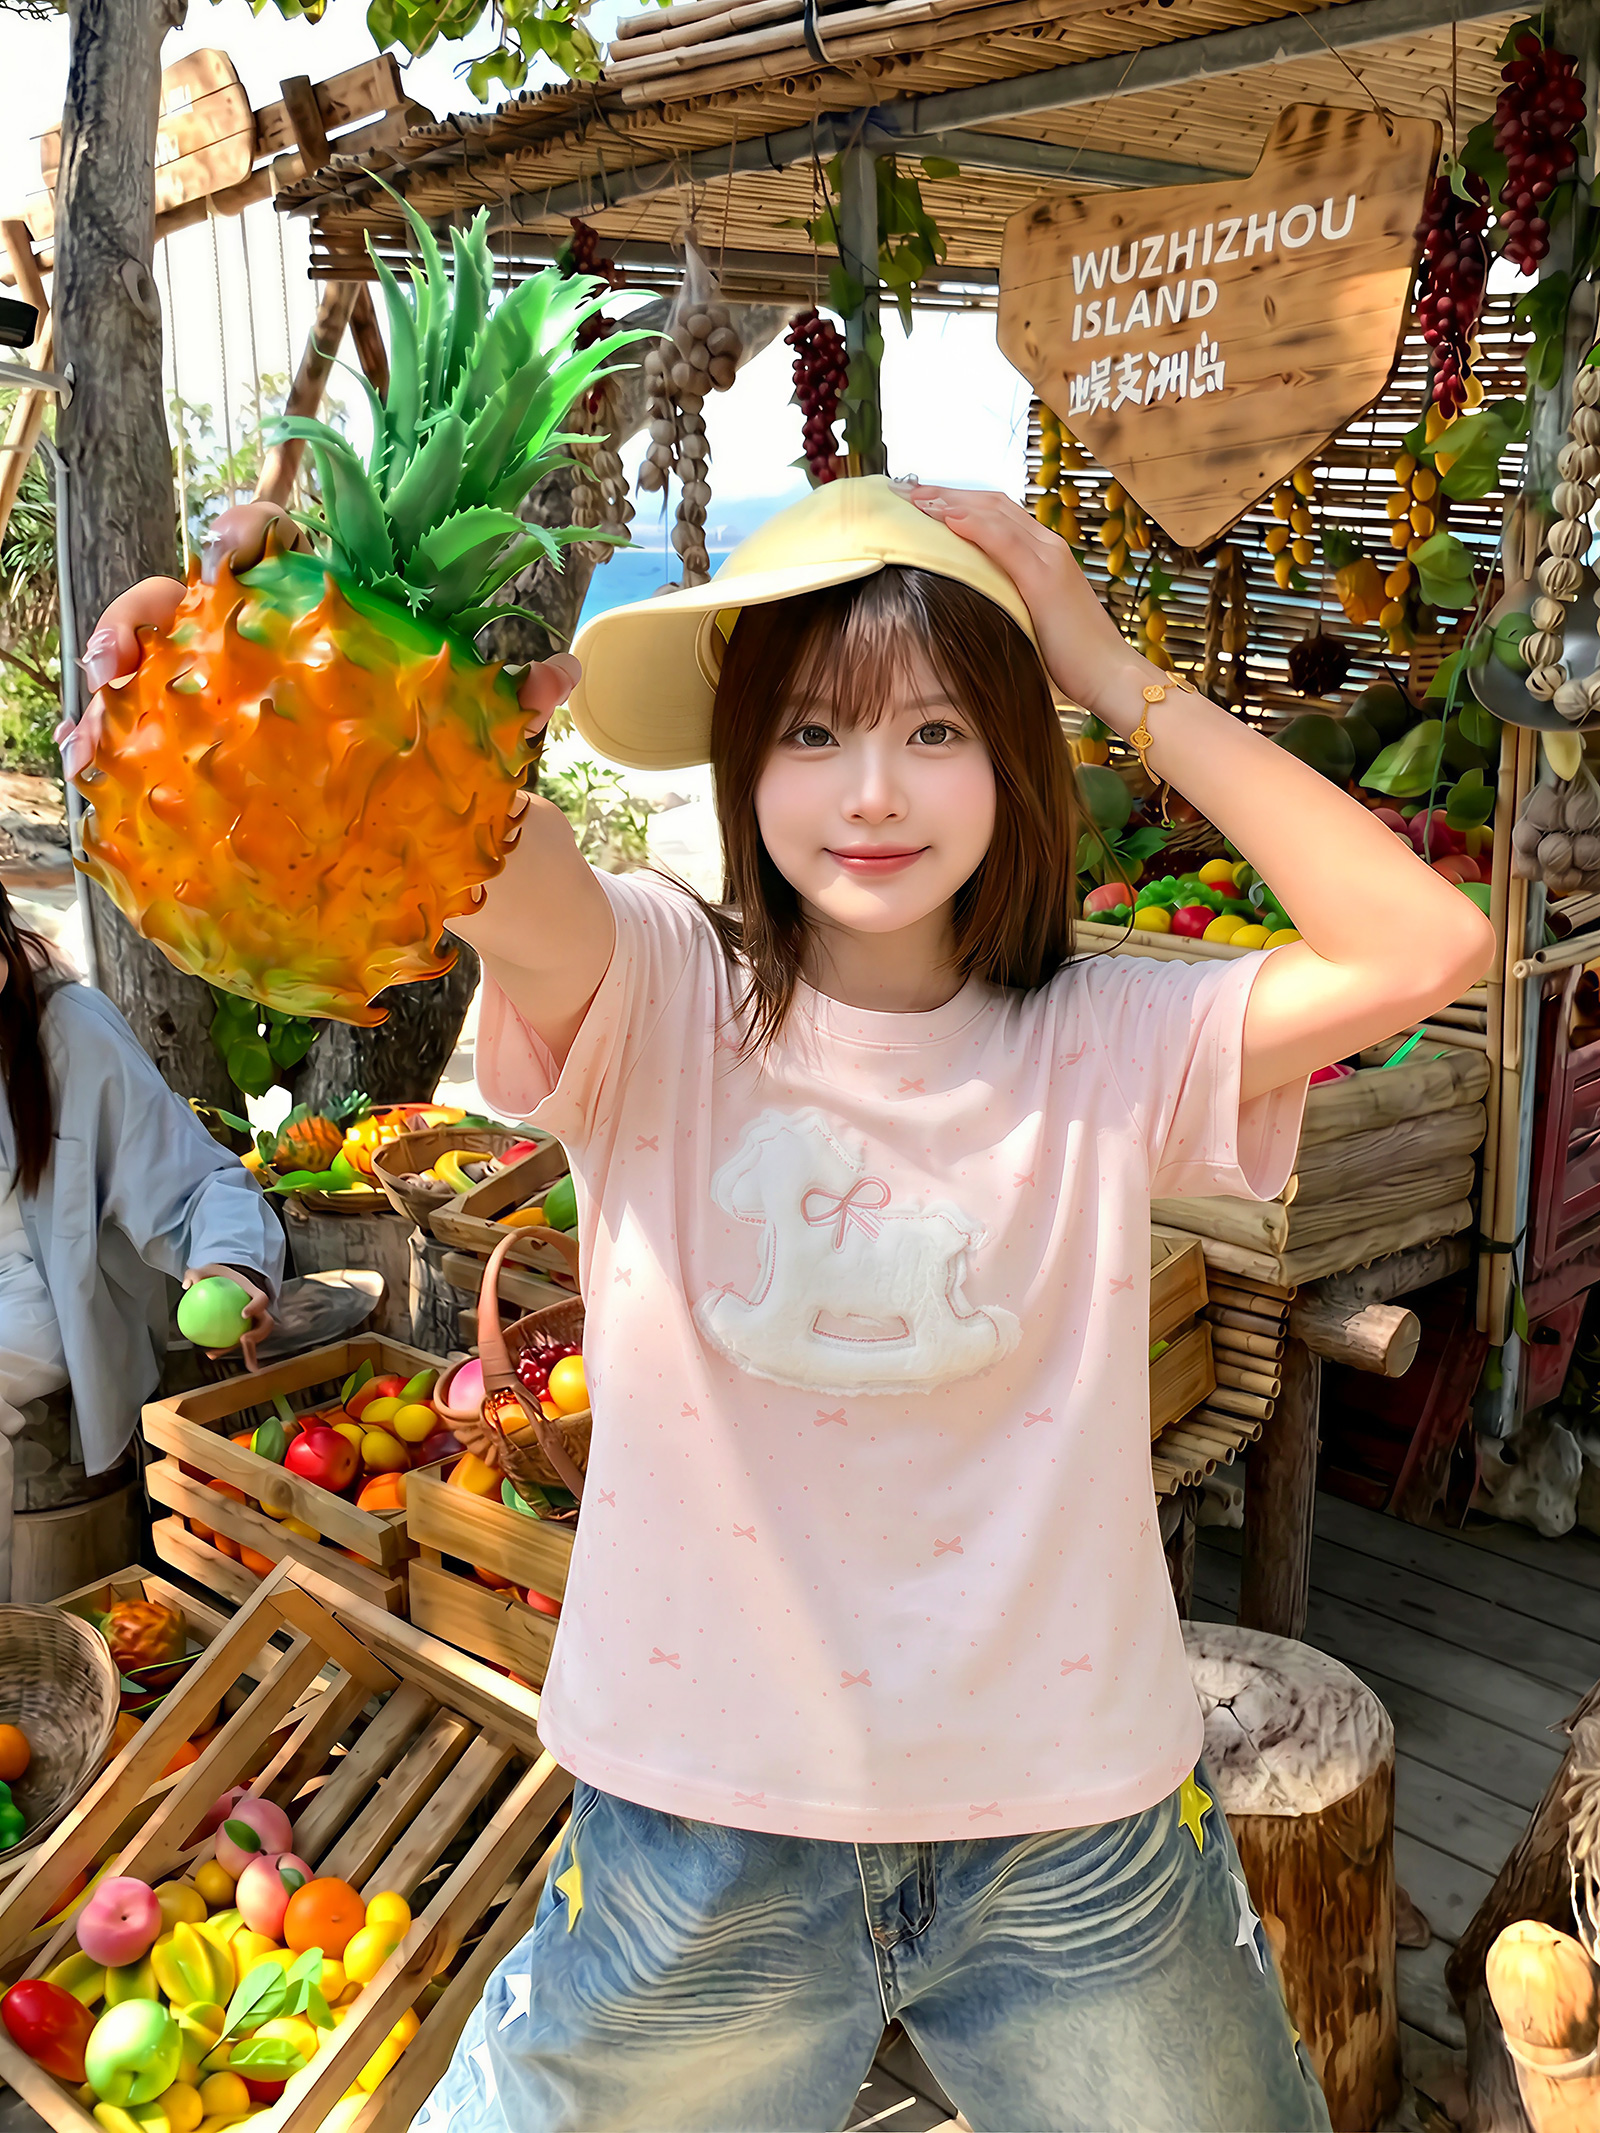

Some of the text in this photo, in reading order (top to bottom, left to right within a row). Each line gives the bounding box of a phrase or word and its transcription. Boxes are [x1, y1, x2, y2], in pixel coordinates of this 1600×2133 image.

[1072, 194, 1356, 295] WUZHIZHOU
[1071, 278, 1219, 342] ISLAND
[1068, 330, 1226, 417] 蜈支洲岛
